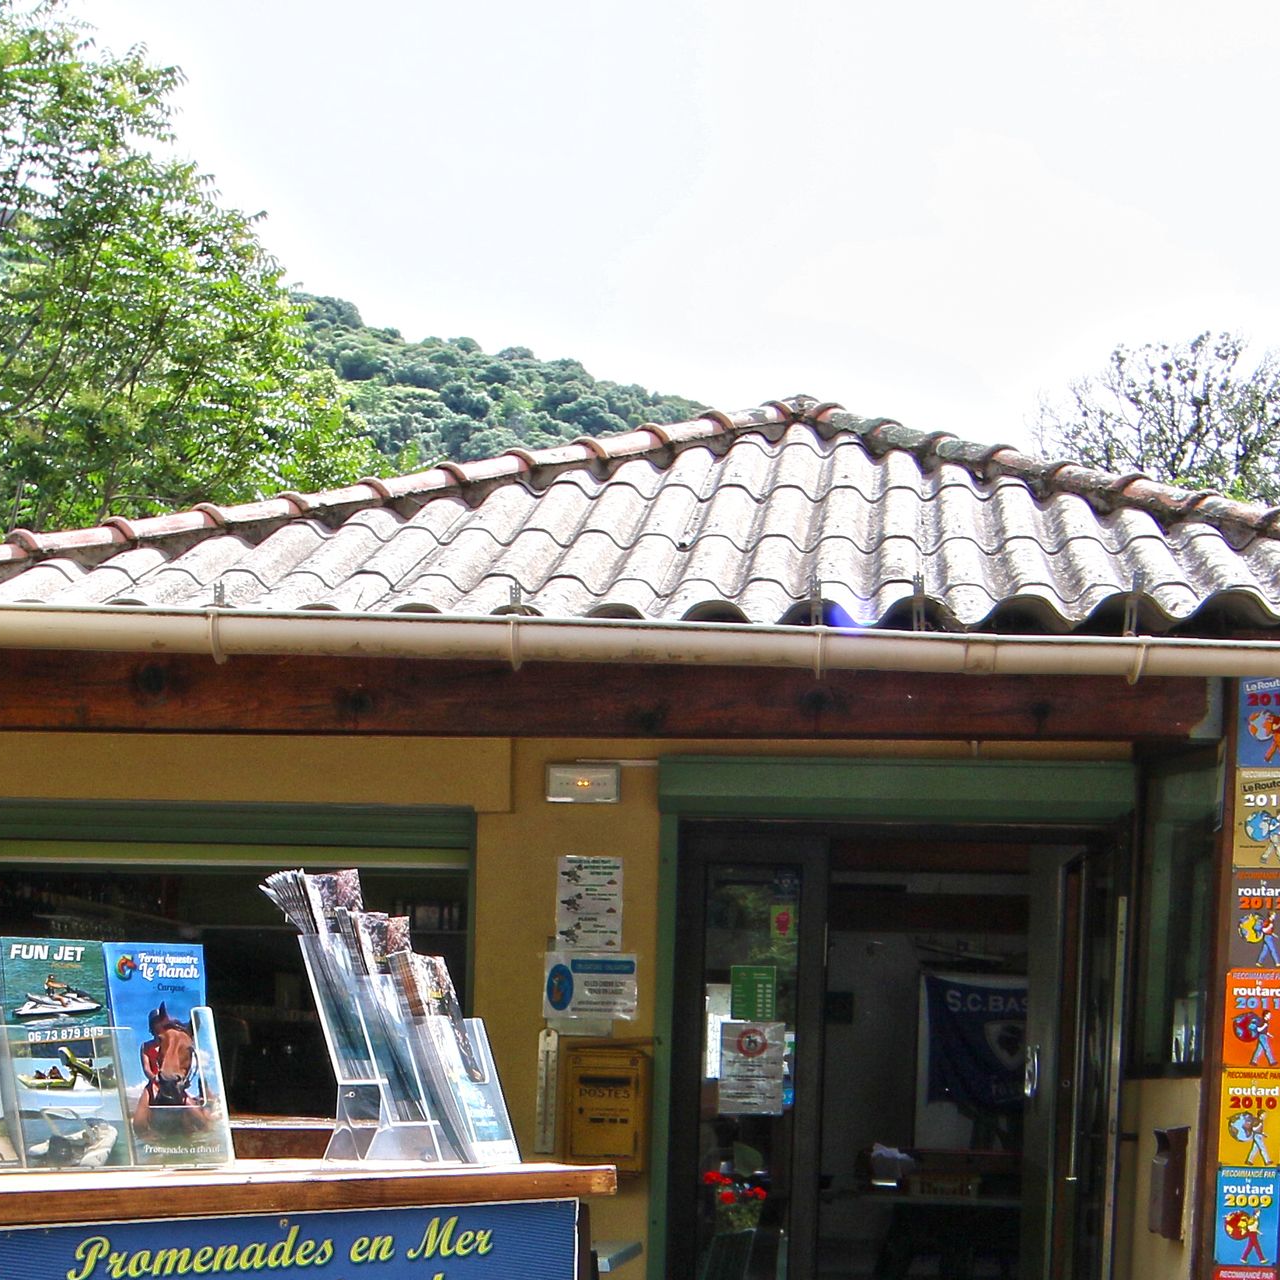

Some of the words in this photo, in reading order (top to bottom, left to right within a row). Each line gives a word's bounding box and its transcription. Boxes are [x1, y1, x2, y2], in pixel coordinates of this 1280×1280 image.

[10, 944, 48, 960] FUN
[53, 946, 85, 962] JET
[138, 953, 163, 964] Ferme
[165, 953, 199, 967] équestre
[138, 964, 155, 981] Le
[157, 965, 200, 979] Ranch
[1235, 997, 1280, 1008] 2011
[28, 1031, 42, 1042] 06
[44, 1030, 58, 1041] 73
[61, 1029, 80, 1040] 879
[580, 1087, 630, 1099] POSTES
[1229, 1085, 1279, 1096] routard
[1230, 1097, 1276, 1109] 2010
[1223, 1183, 1274, 1195] routard
[1224, 1195, 1271, 1207] 2009
[349, 1231, 395, 1262] en
[406, 1216, 494, 1260] Mer
